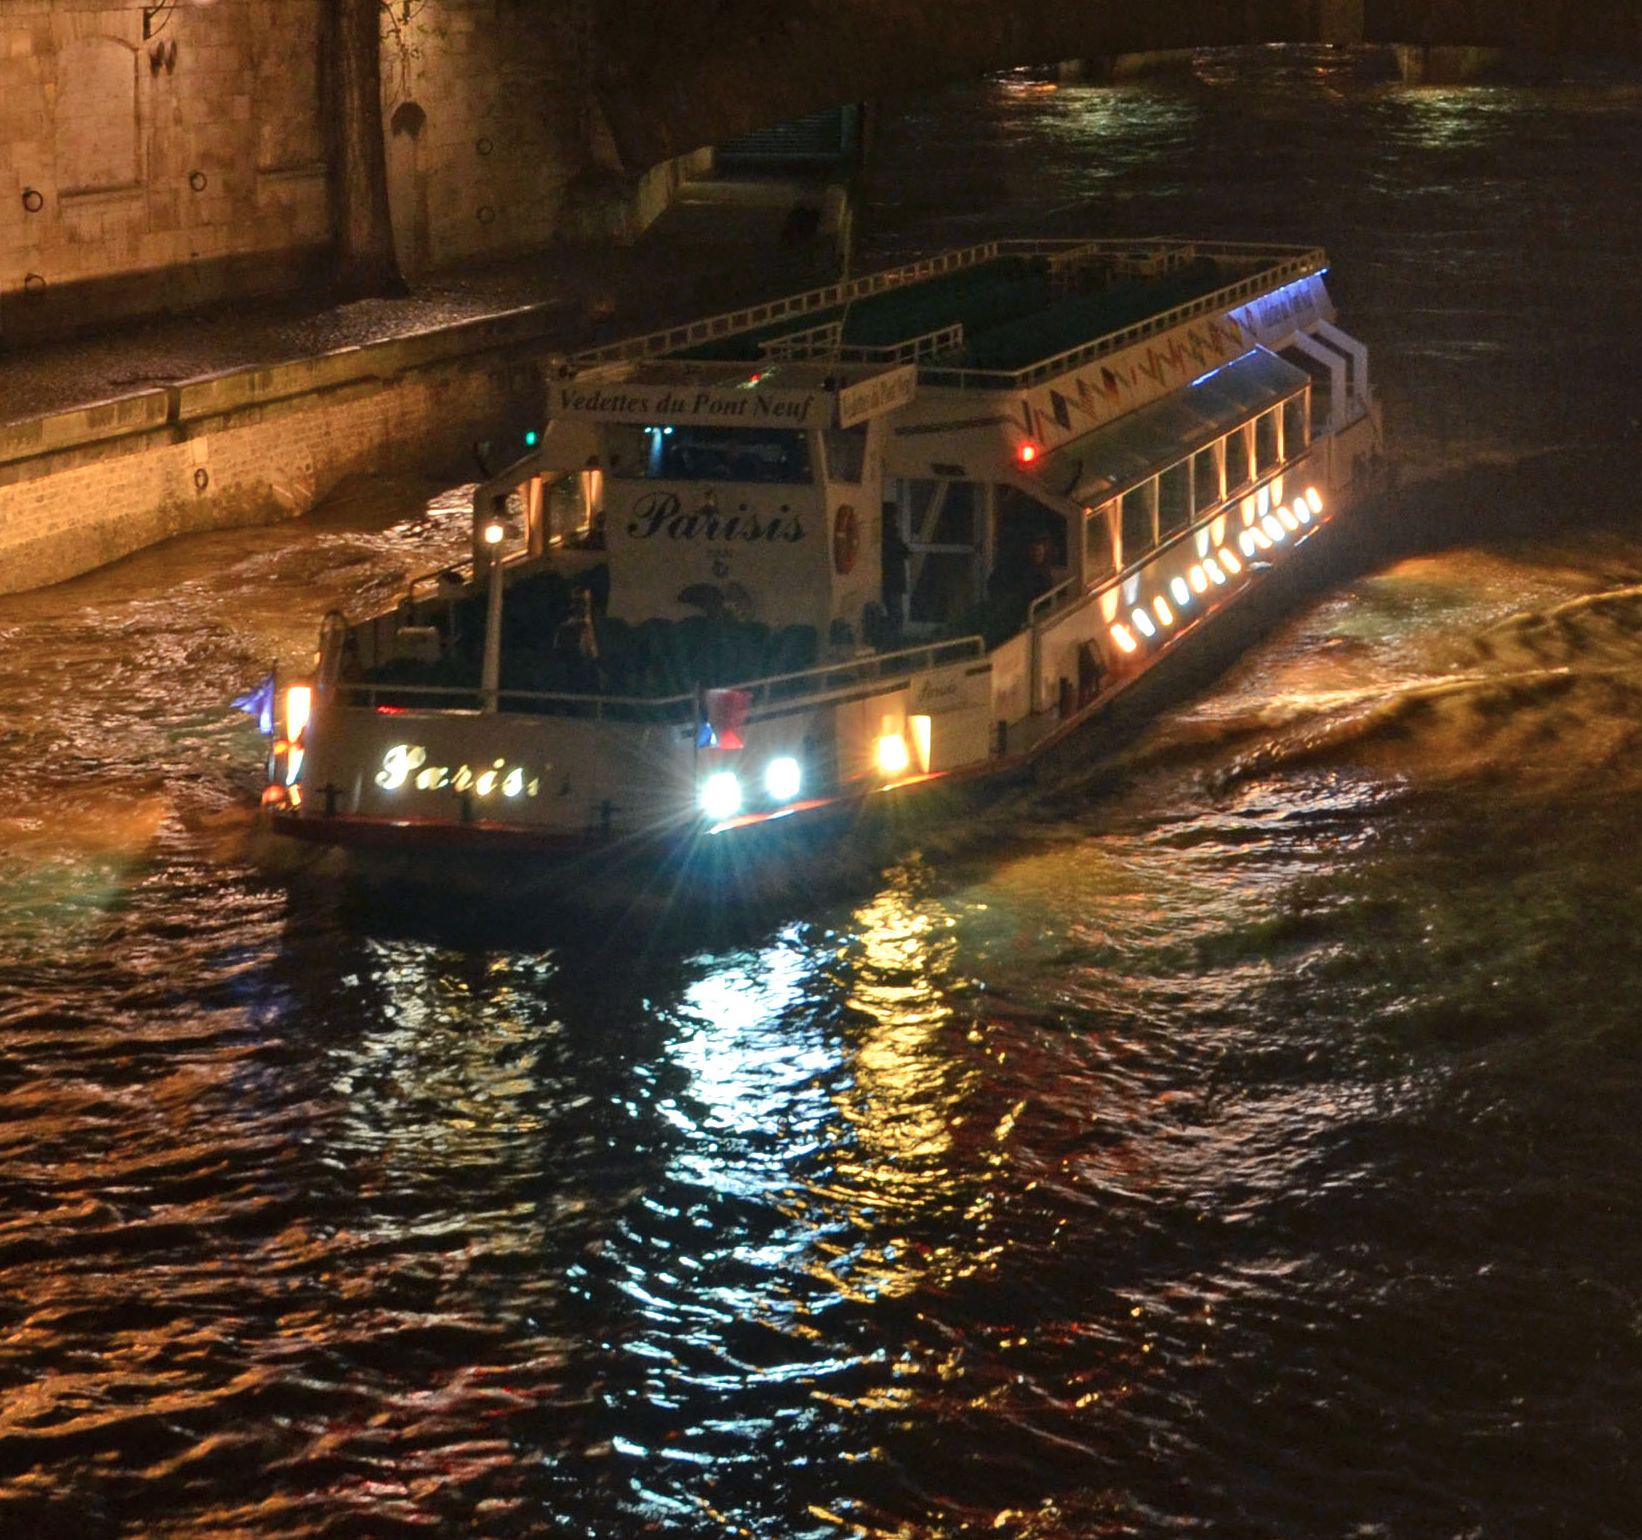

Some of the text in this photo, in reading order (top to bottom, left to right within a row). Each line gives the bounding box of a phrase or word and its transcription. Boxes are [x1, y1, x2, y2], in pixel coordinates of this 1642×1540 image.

[560, 390, 648, 413] Vedettes
[658, 392, 685, 414] du
[691, 394, 746, 416] Pont
[754, 395, 815, 419] Neuf
[627, 491, 807, 542] Parisis
